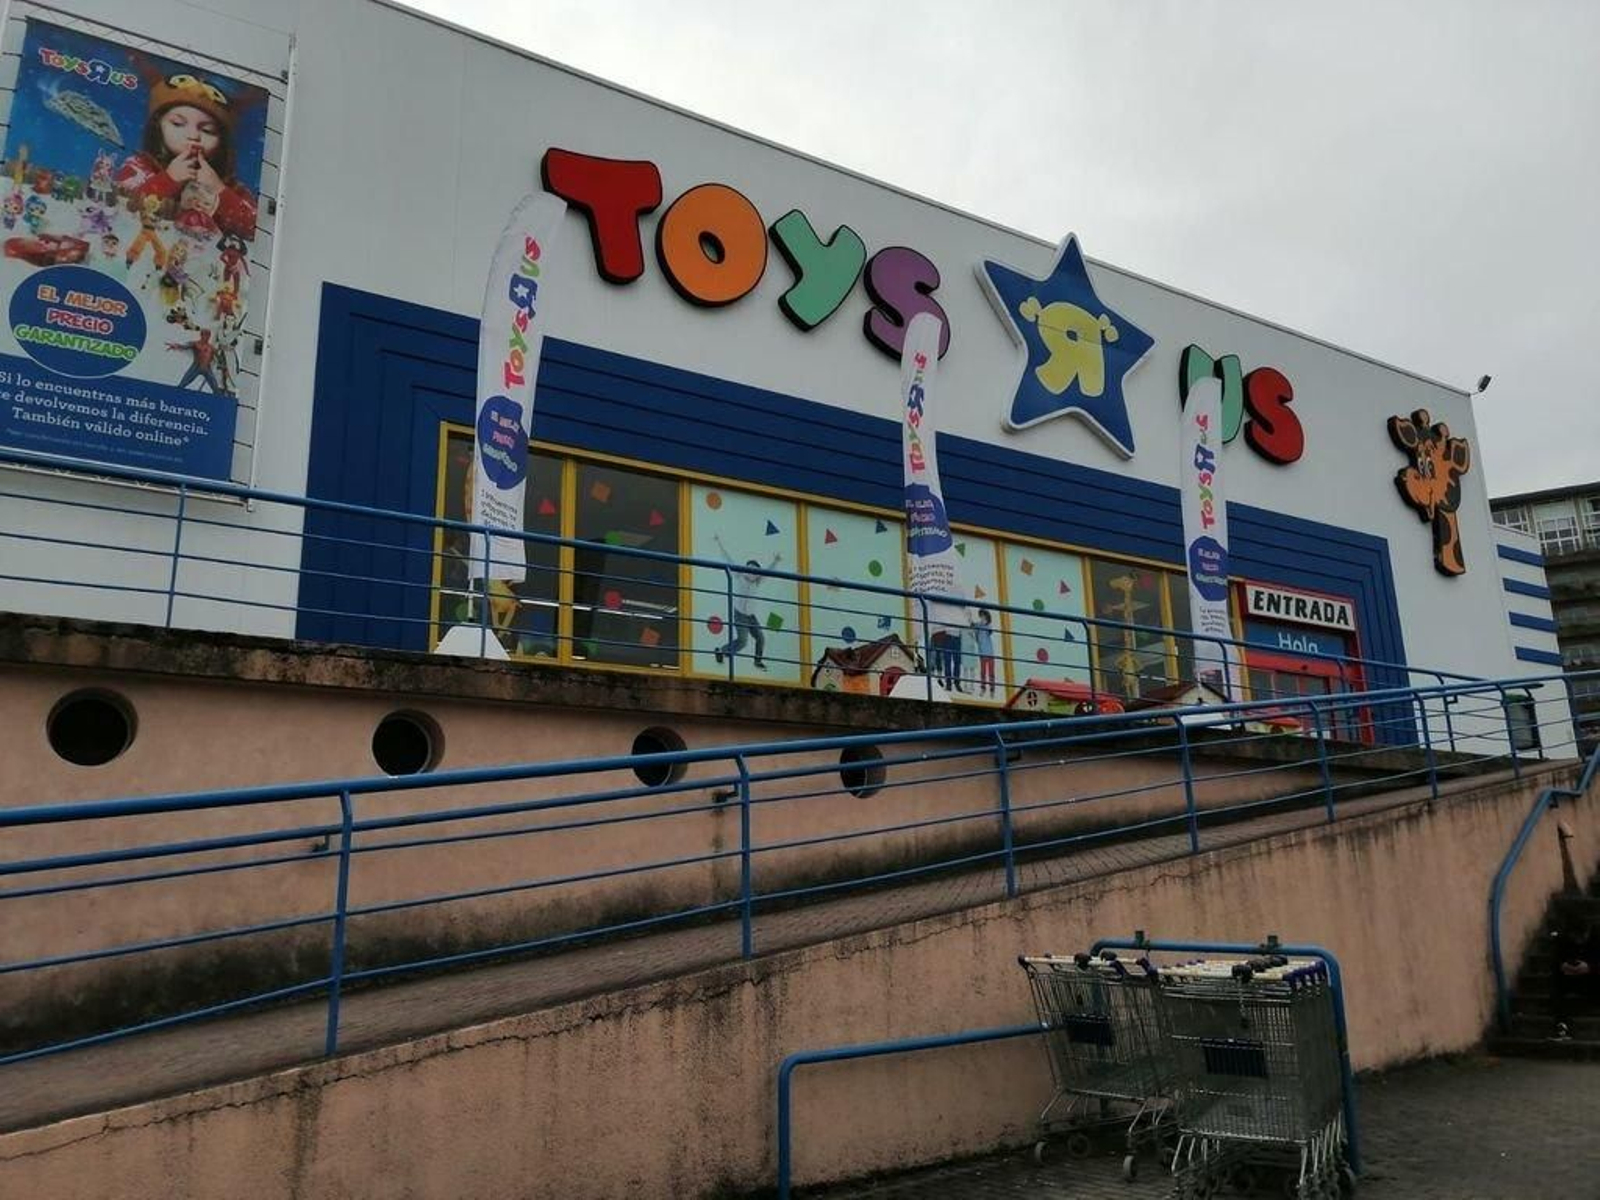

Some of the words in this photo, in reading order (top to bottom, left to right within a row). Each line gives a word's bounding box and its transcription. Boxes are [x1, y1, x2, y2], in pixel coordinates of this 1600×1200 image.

[541, 147, 950, 360] TOYS
[38, 285, 59, 303] EL
[65, 290, 128, 317] MEJOR
[46, 308, 114, 334] PRECIO
[14, 324, 139, 360] GARANTIZADO
[14, 390, 108, 418] devolvemos
[112, 407, 125, 421] la
[129, 411, 209, 436] diferencia.
[16, 373, 32, 387] lo
[35, 380, 122, 404] encuentras
[126, 396, 156, 411] más
[160, 400, 210, 422] barato,
[12, 407, 80, 429] También
[85, 418, 132, 438] válido
[1253, 590, 1349, 626] ENTRADA
[1278, 632, 1318, 654] Hola
